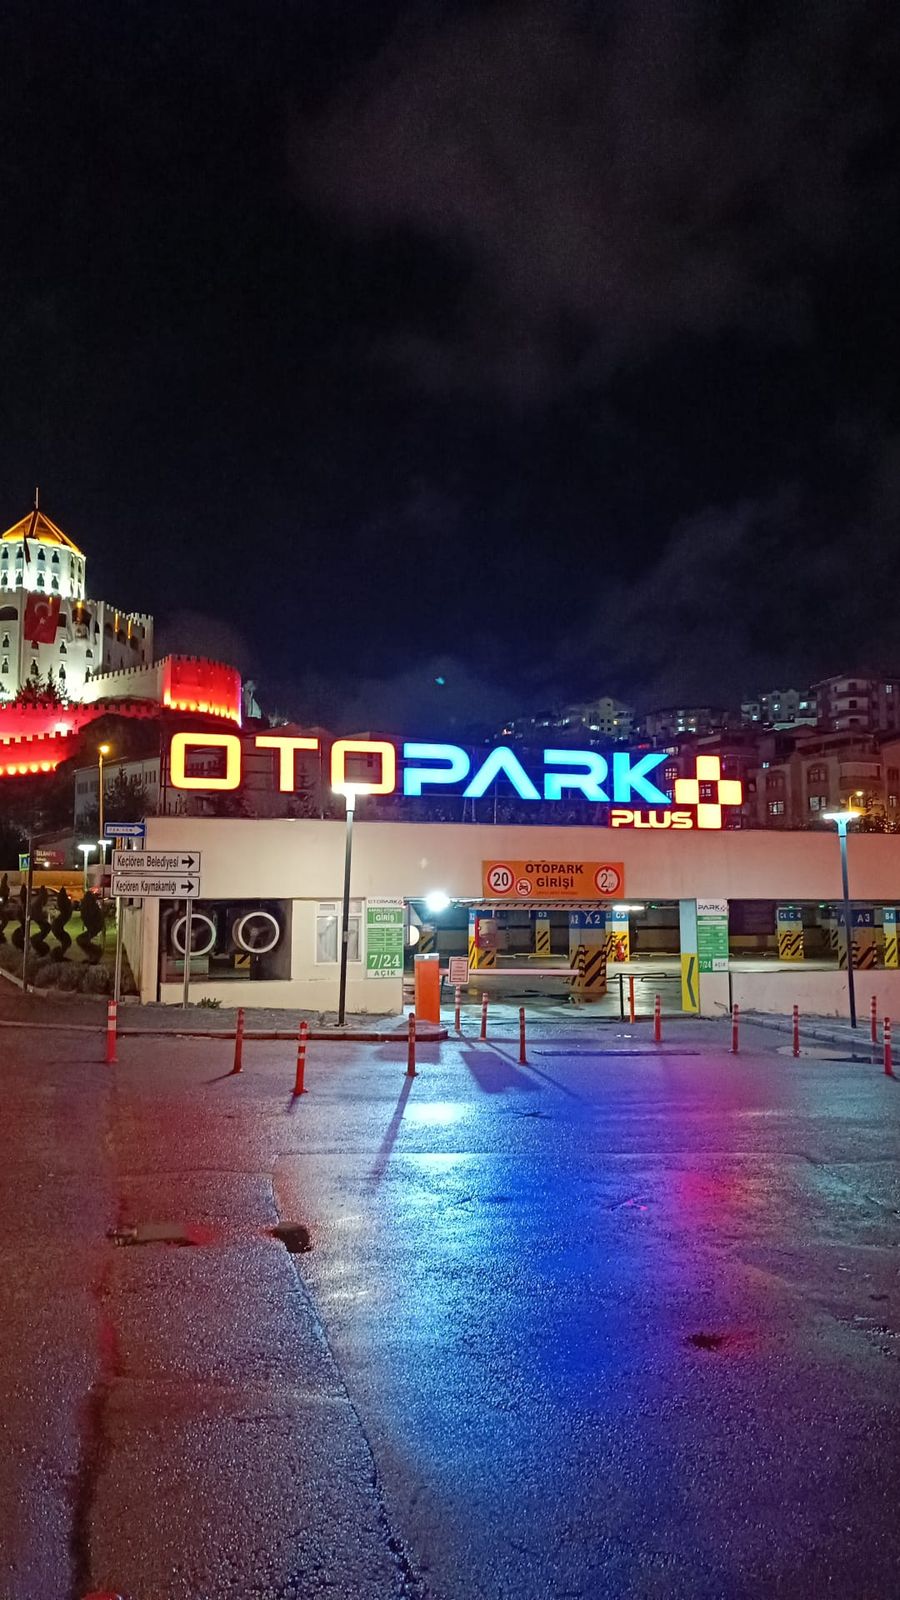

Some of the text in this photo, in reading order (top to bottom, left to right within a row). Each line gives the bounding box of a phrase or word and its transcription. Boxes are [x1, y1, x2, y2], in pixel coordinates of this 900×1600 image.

[170, 733, 671, 804] OTOPARK
[611, 809, 693, 829] PLUS
[525, 864, 583, 873] OTOPARK
[493, 872, 509, 887] 20
[536, 876, 574, 889] GİRİŞİ
[370, 954, 401, 969] 7/24
[374, 970, 396, 978] AÇIK
